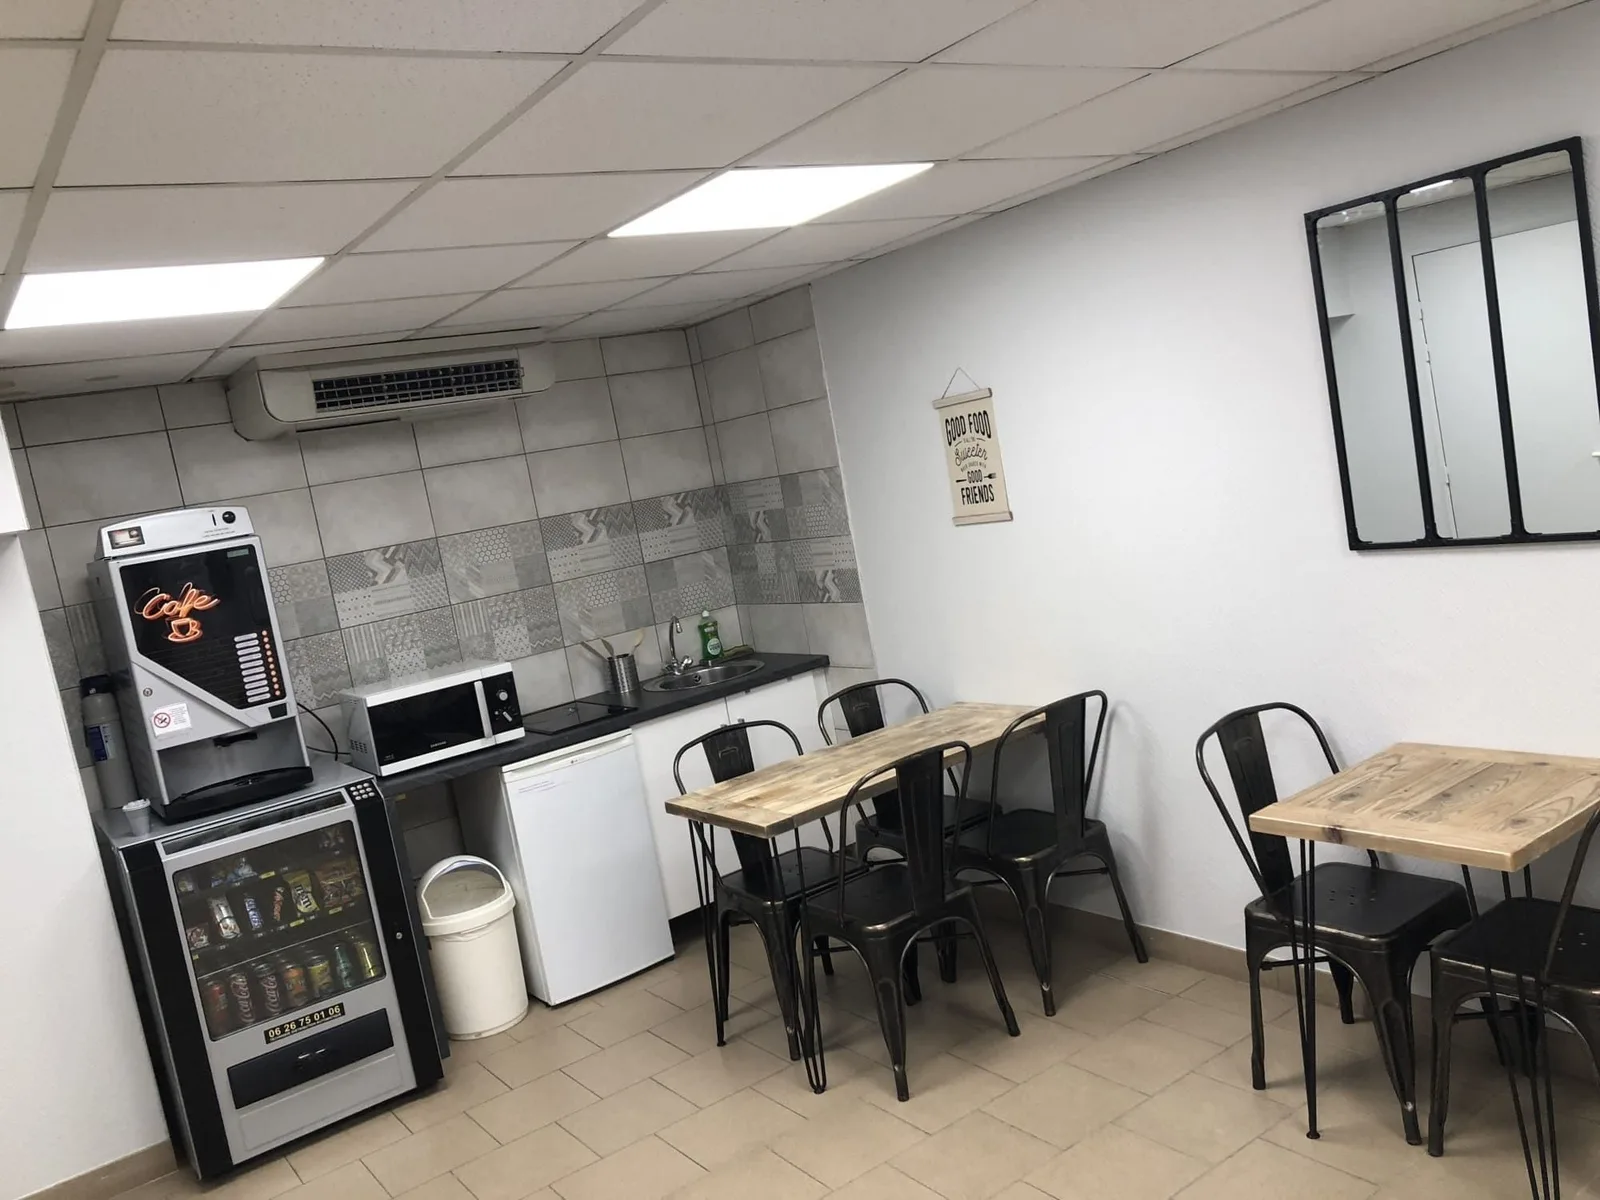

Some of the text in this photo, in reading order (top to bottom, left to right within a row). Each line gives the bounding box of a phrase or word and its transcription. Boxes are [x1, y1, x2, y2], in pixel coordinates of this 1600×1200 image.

[945, 410, 992, 446] GOOD FOOD
[954, 443, 988, 466] Sweeter
[967, 469, 983, 484] GOOD
[960, 483, 995, 505] FRIENDS
[268, 1005, 341, 1038] 06 26 75 01 06
